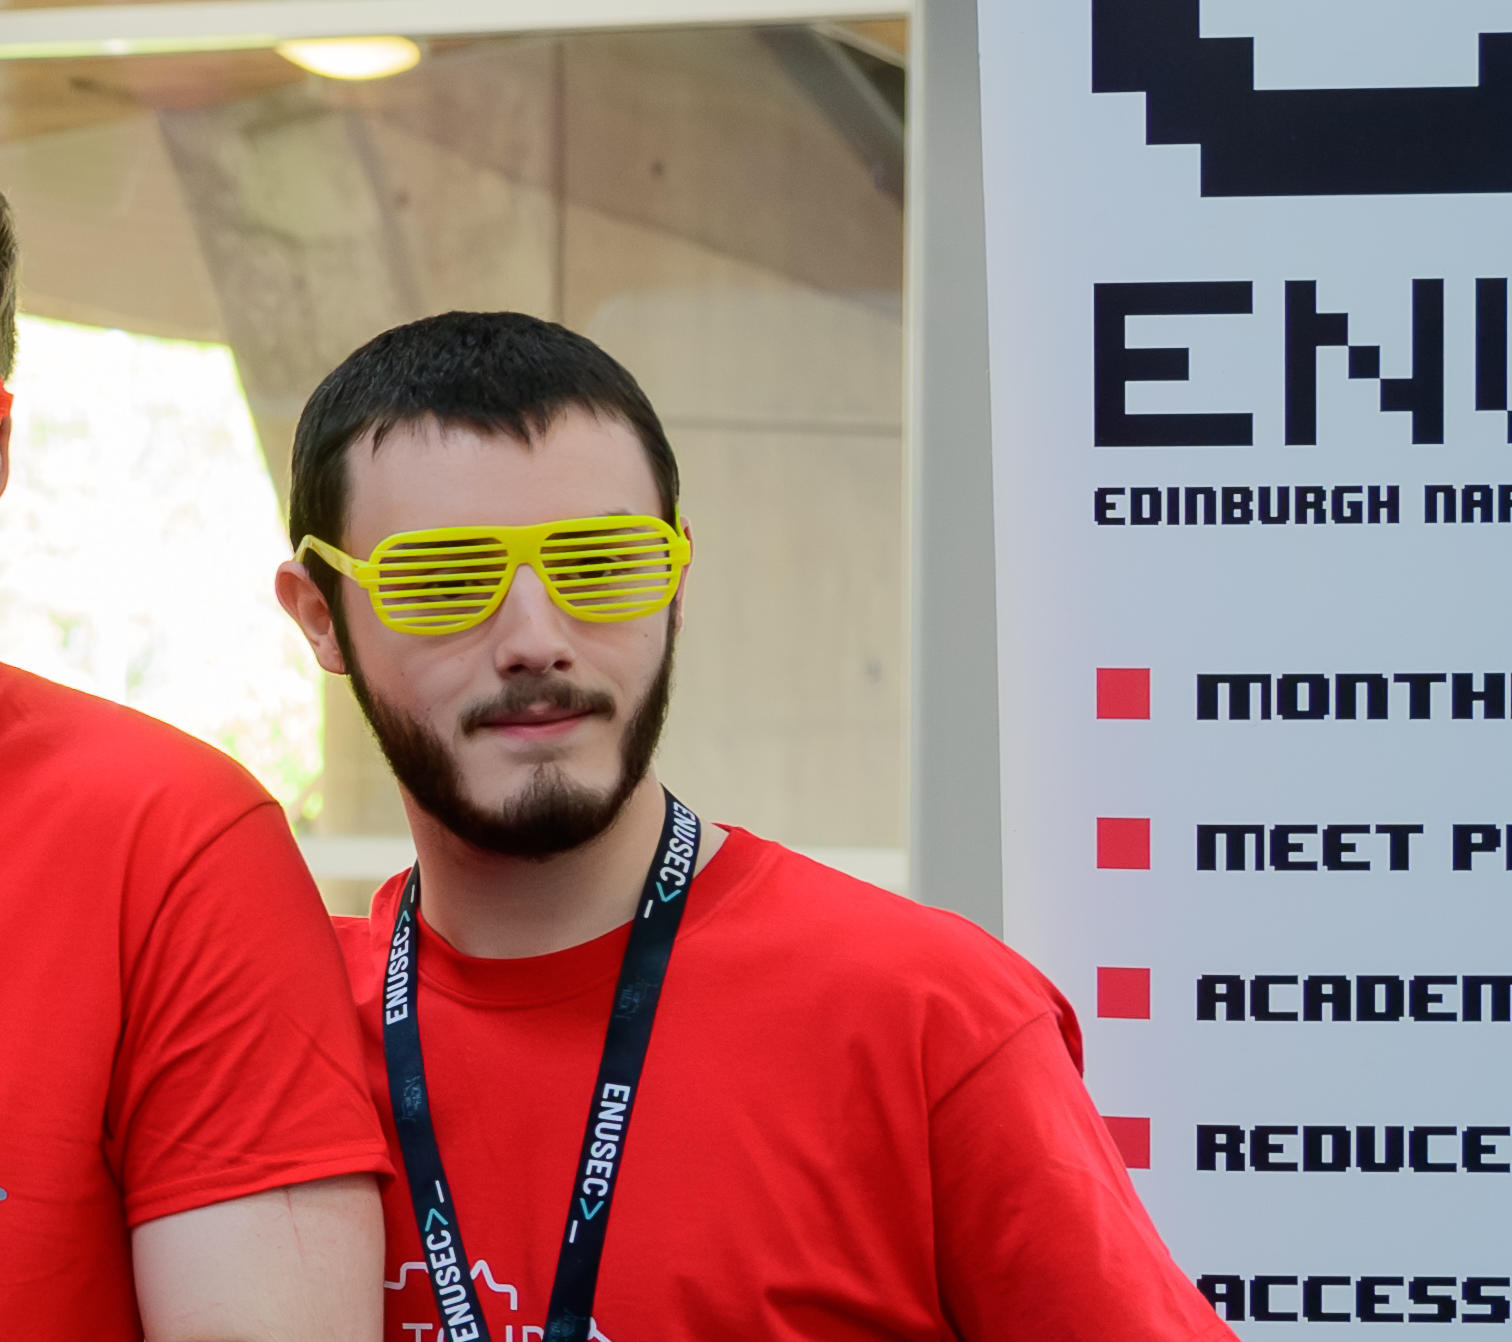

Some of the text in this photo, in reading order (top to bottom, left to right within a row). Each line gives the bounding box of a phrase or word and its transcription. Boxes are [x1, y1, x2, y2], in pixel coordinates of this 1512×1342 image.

[1092, 277, 1512, 448] EN
[1093, 484, 1401, 526] EDINBURGH
[1196, 672, 1512, 721] MONTH
[1196, 823, 1512, 872] MEET P
[1196, 974, 1512, 1022] ACADEM
[1196, 1123, 1512, 1173] REDUCE
[1196, 1274, 1511, 1323] ACCESS
